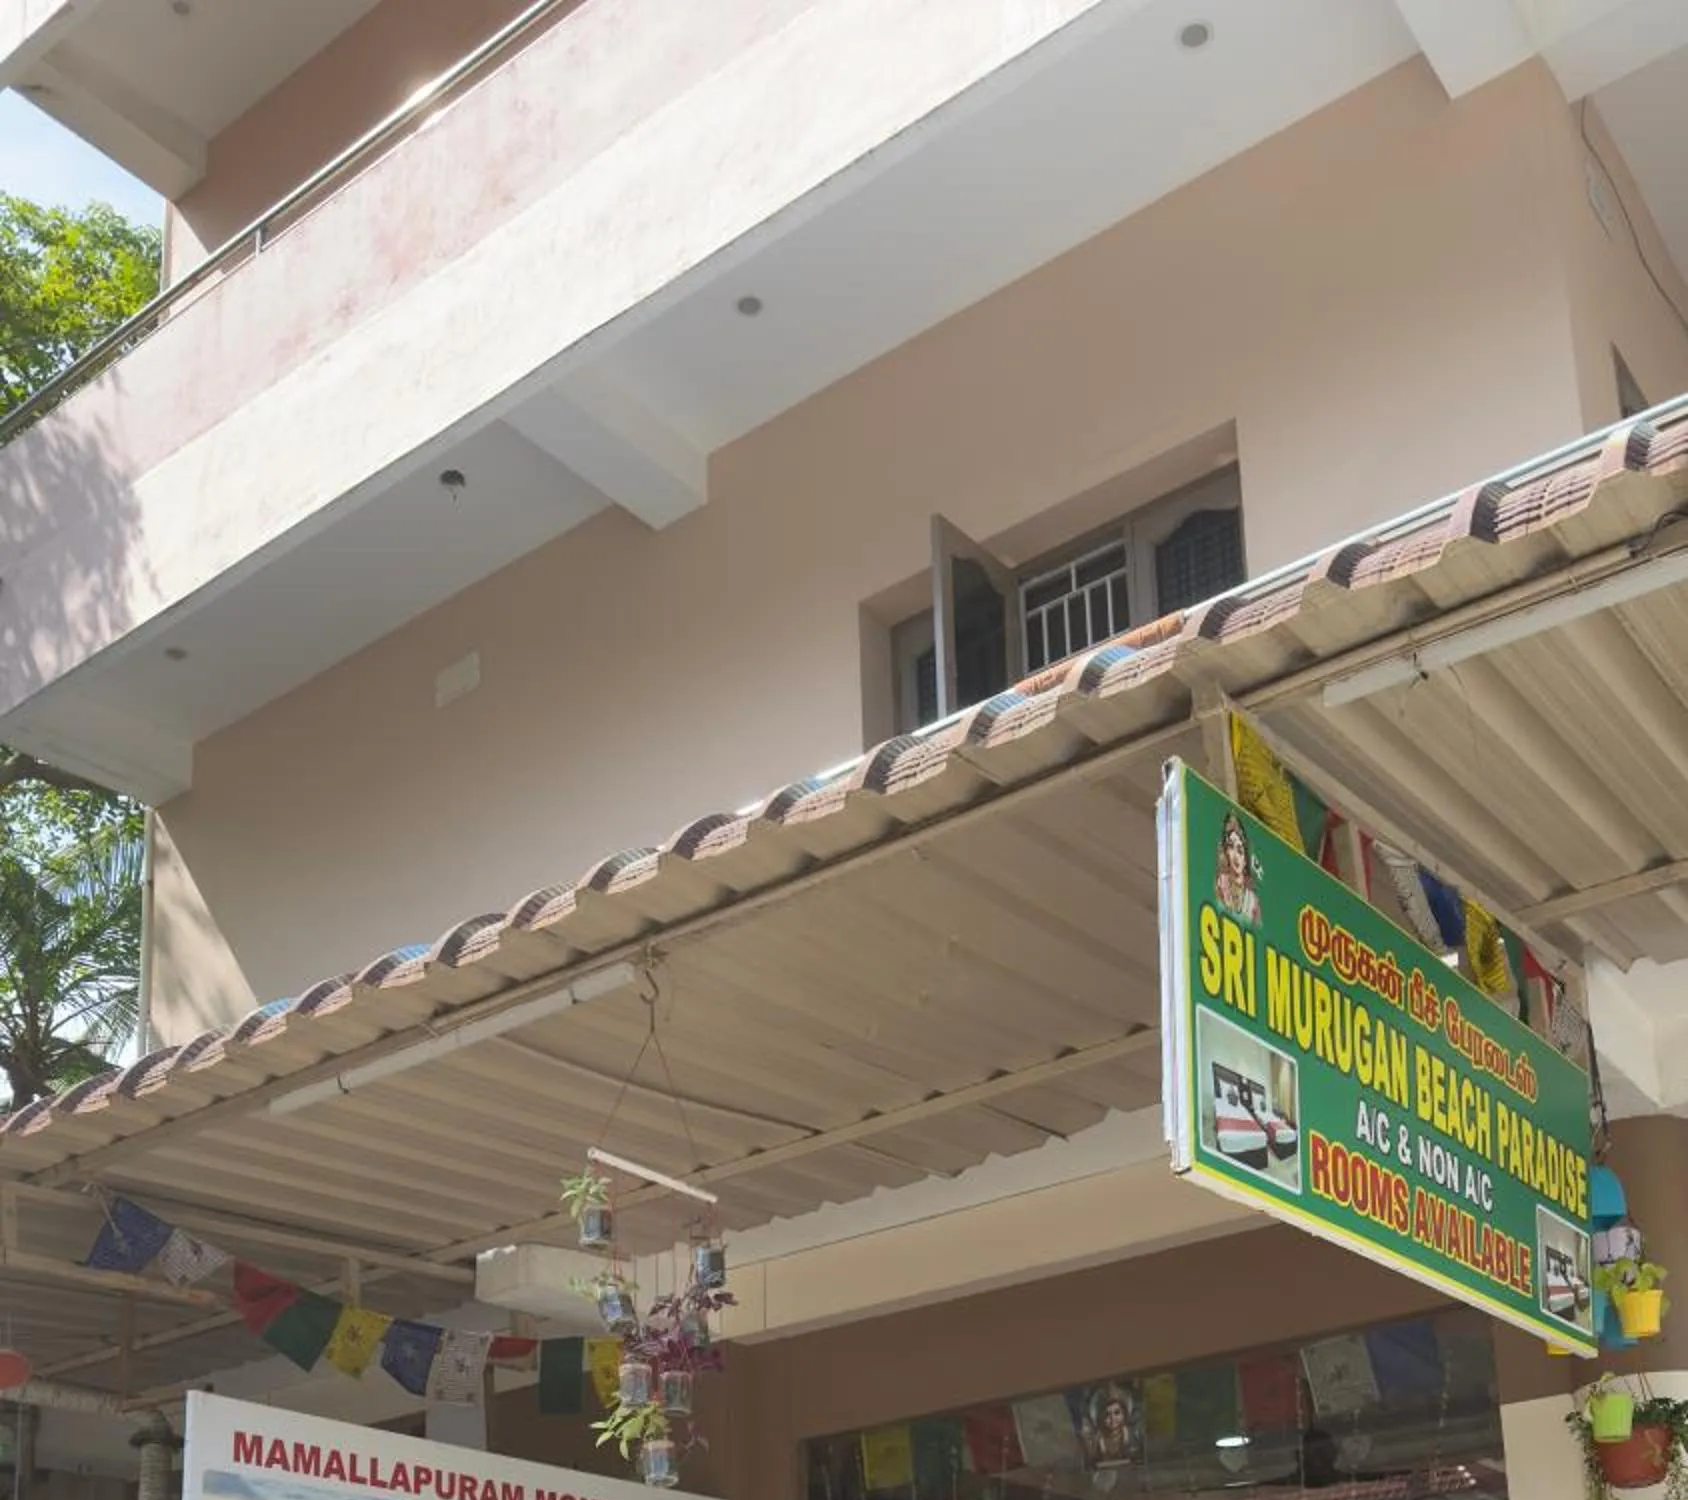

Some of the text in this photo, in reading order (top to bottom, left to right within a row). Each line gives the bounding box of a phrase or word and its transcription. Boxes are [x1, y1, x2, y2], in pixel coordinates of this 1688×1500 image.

[1299, 903, 1405, 1010] முருகன்
[1407, 967, 1442, 1033] பீச்
[1199, 904, 1588, 1221] SRI MURUGAN BEACH PARADISE
[1309, 1129, 1533, 1296] ROOMS AVAILABLE
[1356, 1101, 1494, 1211] A/C & NON A/C
